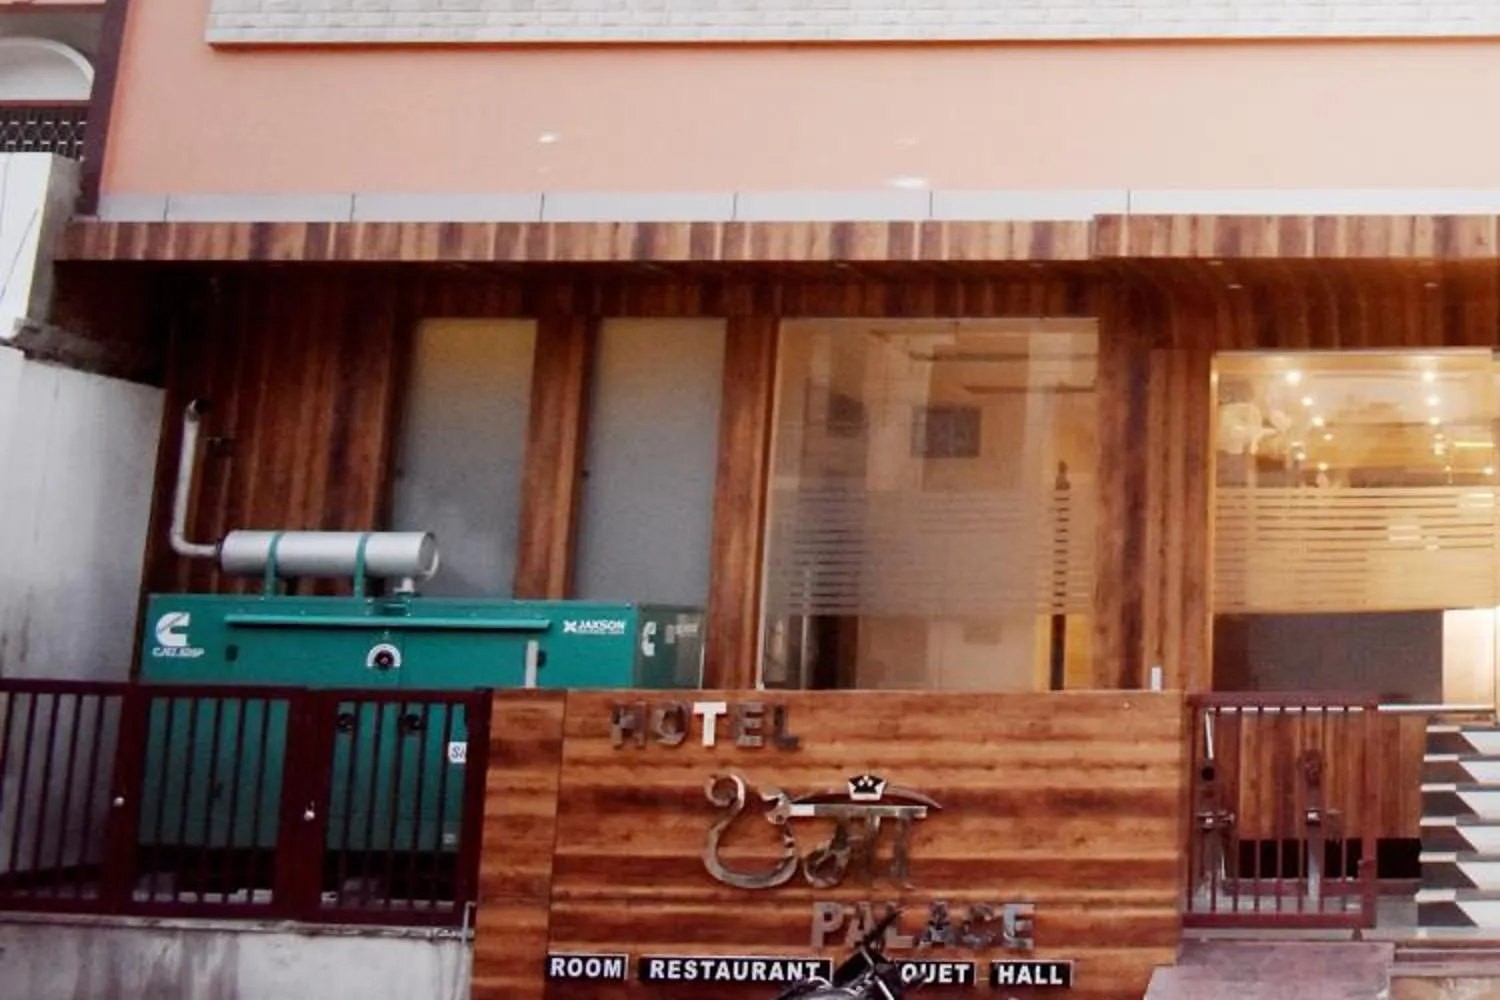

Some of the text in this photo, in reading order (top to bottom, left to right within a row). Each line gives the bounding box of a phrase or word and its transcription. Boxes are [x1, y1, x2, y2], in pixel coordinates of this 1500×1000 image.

[610, 701, 800, 749] HOTEL
[810, 901, 1035, 949] PALACE
[550, 957, 622, 978] ROOM
[650, 959, 820, 981] RESTAURANT
[998, 963, 1063, 985] HALL
